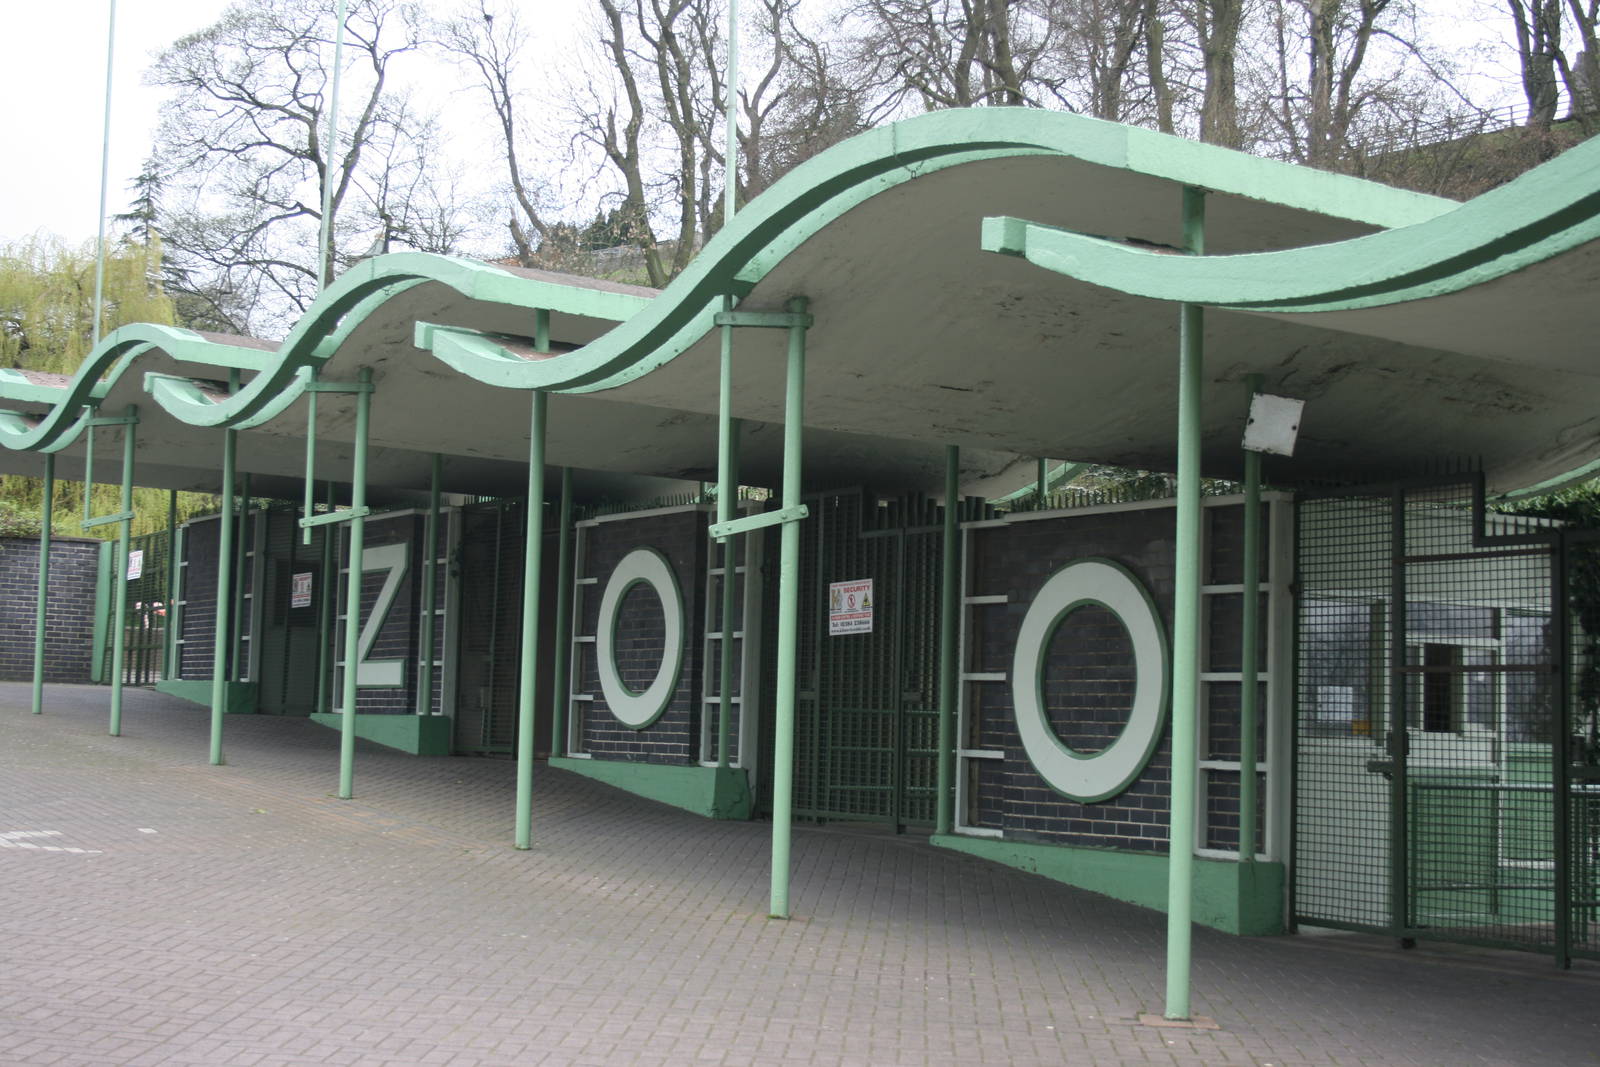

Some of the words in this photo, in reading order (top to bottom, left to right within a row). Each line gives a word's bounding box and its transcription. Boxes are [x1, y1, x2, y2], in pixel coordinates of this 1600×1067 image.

[843, 585, 870, 593] SECURITY
[355, 543, 408, 688] Z
[597, 546, 684, 730] O
[1012, 557, 1169, 804] O
